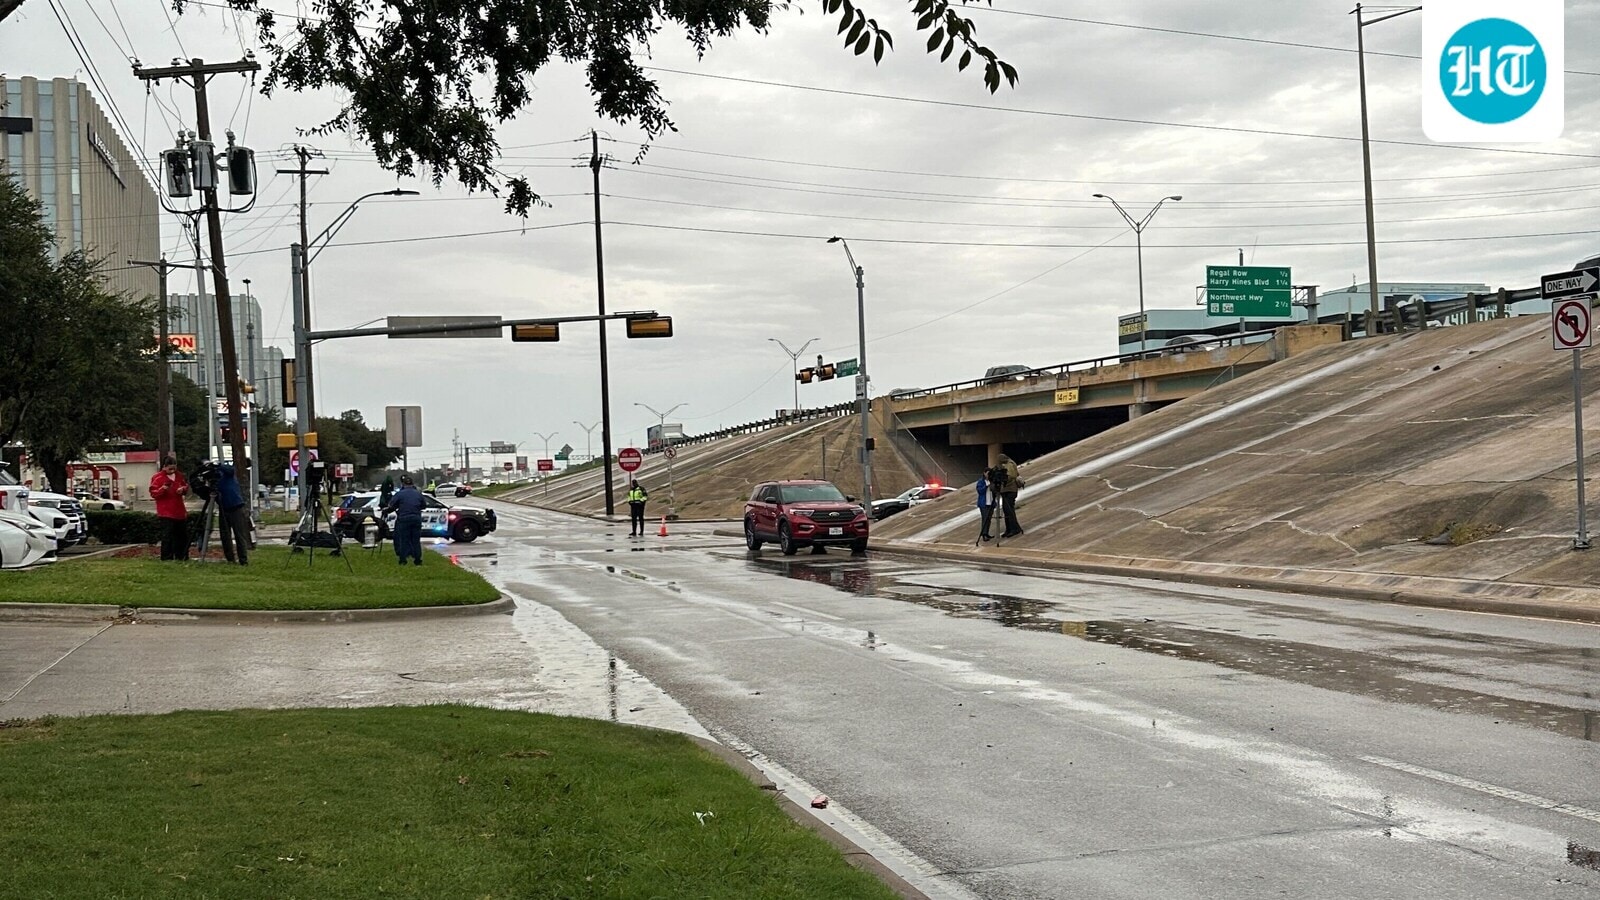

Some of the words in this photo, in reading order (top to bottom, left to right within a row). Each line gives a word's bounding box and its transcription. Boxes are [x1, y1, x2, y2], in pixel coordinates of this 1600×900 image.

[1209, 269, 1230, 277] Regal
[1232, 269, 1248, 277] Row
[1209, 278, 1230, 286] Harry
[1232, 278, 1252, 286] Hines
[1254, 278, 1270, 286] Blvd
[1547, 280, 1563, 292] ONE
[1565, 277, 1582, 289] WAY
[1248, 294, 1264, 302] Hwy
